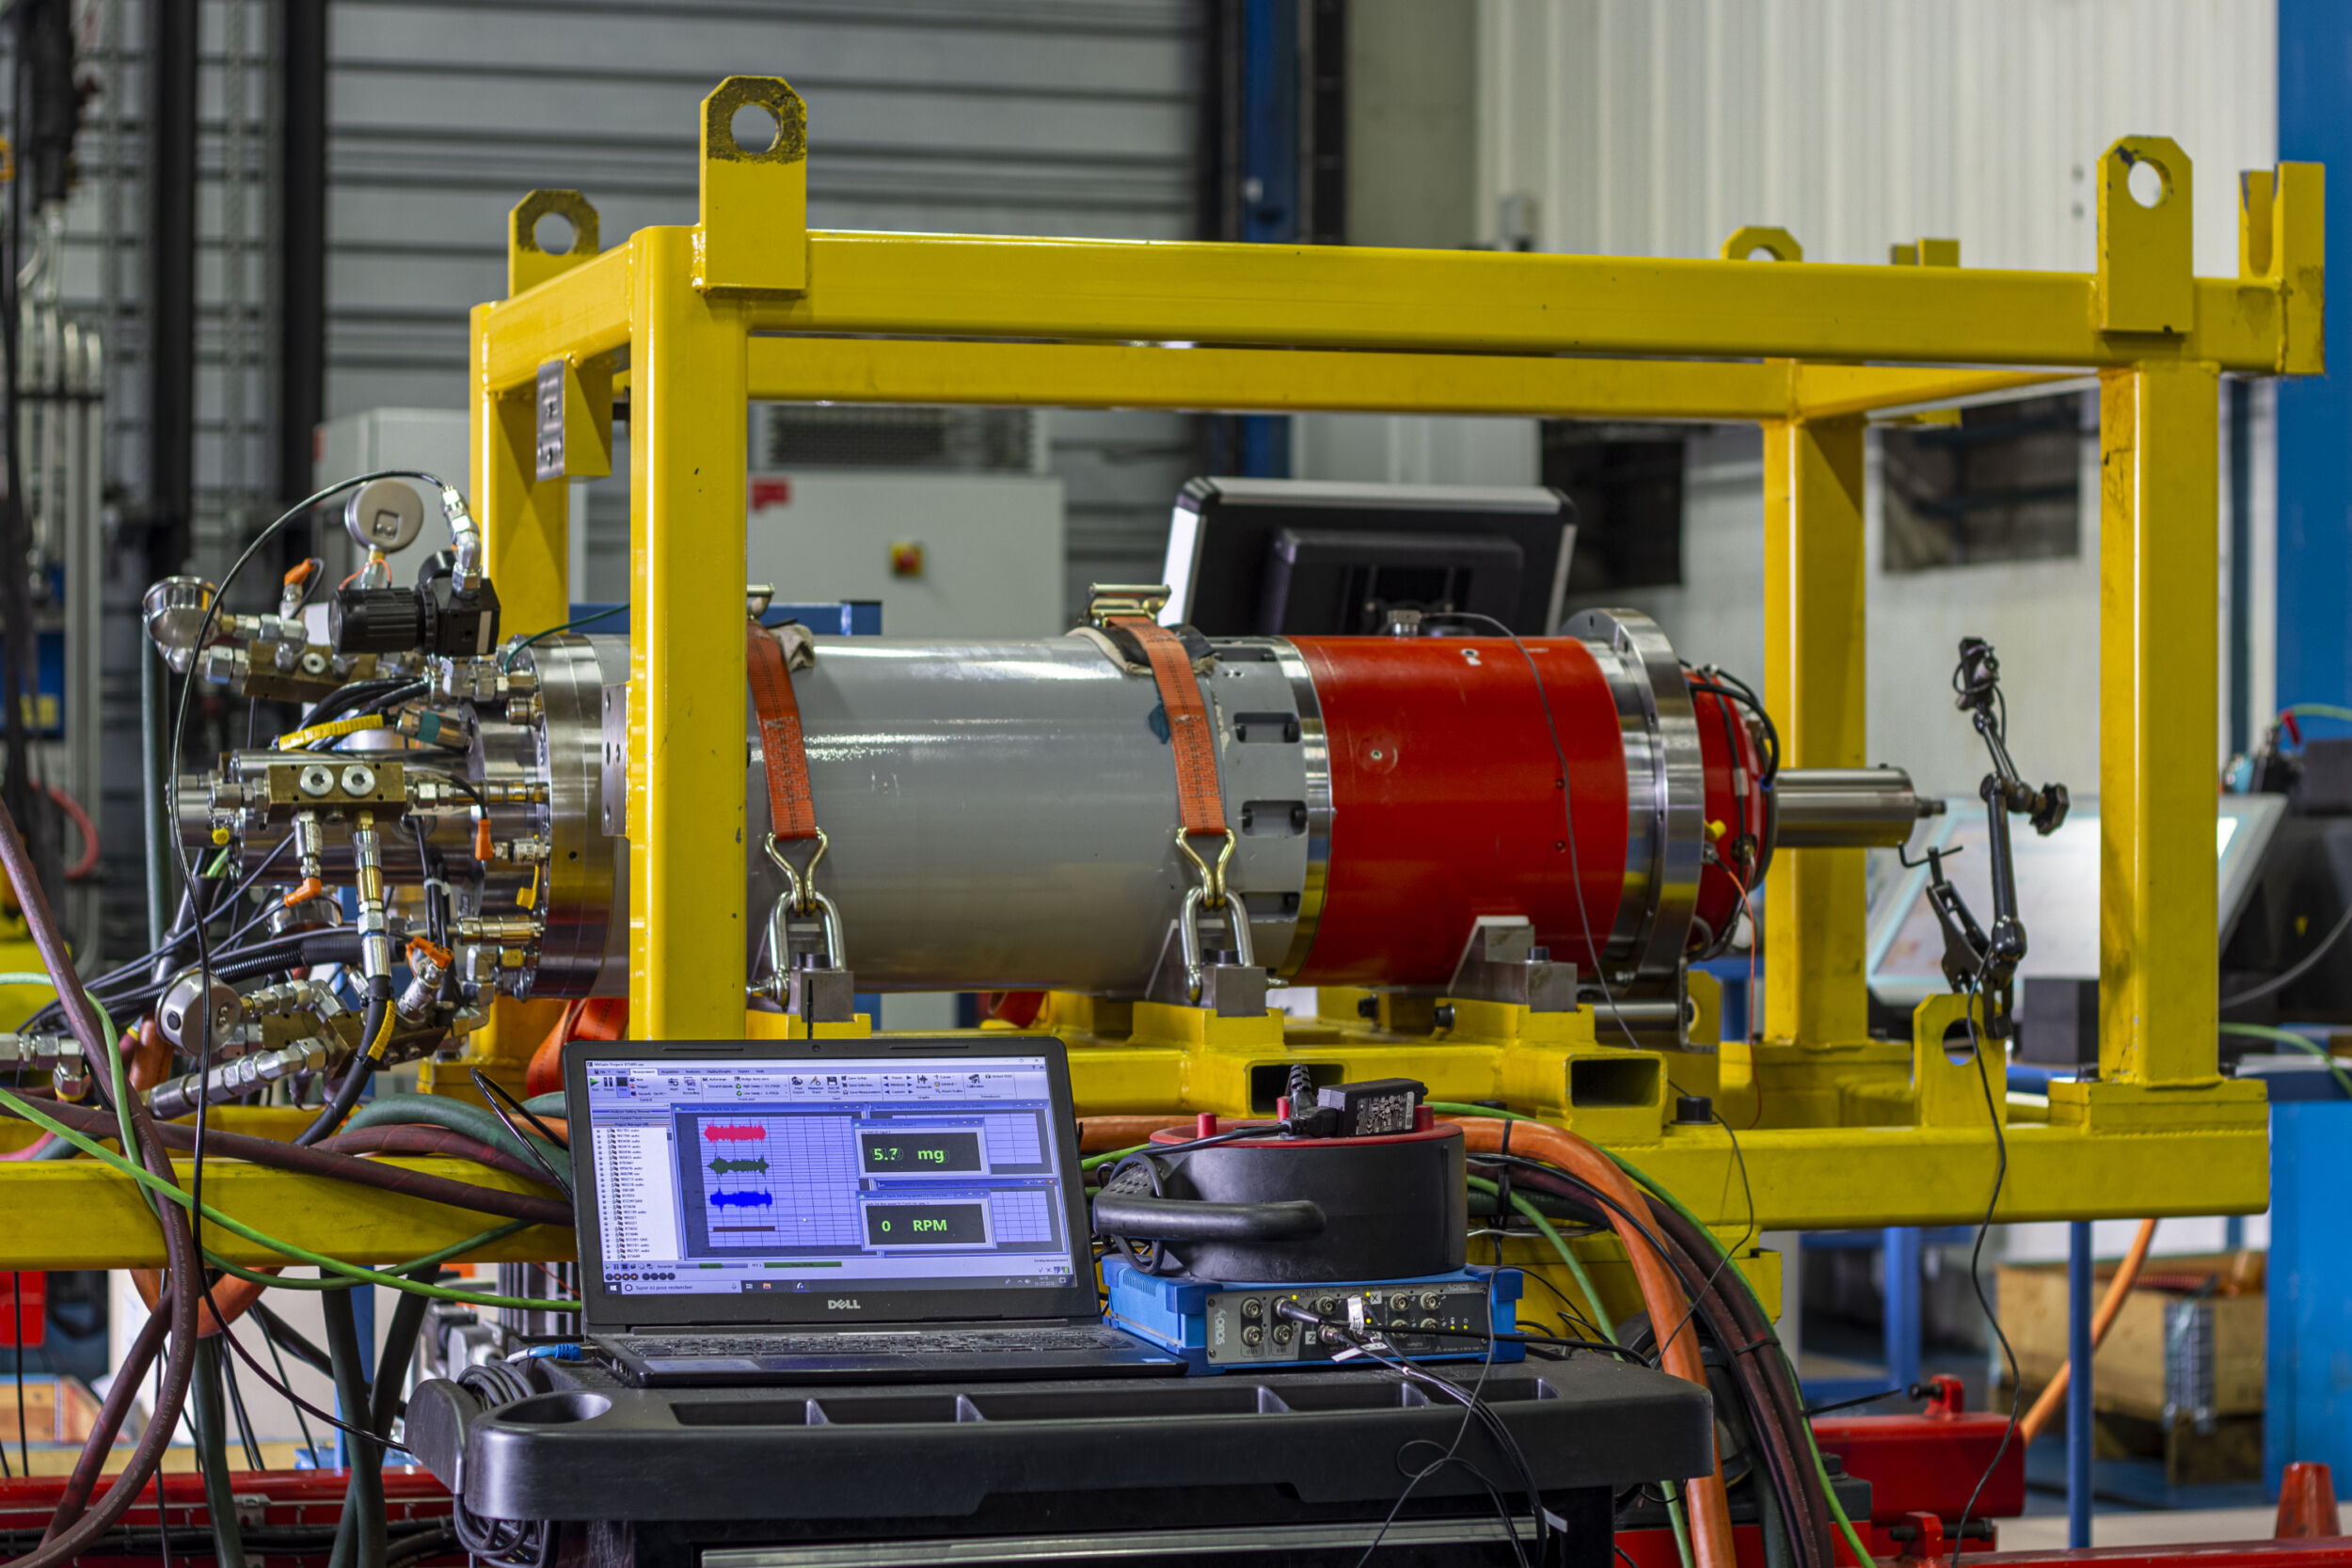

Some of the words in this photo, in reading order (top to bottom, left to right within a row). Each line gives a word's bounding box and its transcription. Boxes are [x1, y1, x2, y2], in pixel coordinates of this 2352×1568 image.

[917, 1149, 945, 1164] mg
[882, 1220, 891, 1232] 0
[913, 1219, 947, 1231] RPM
[180, 1263, 188, 1297] France
[827, 1299, 861, 1310] DELL
[1215, 1317, 1226, 1346] OROS
